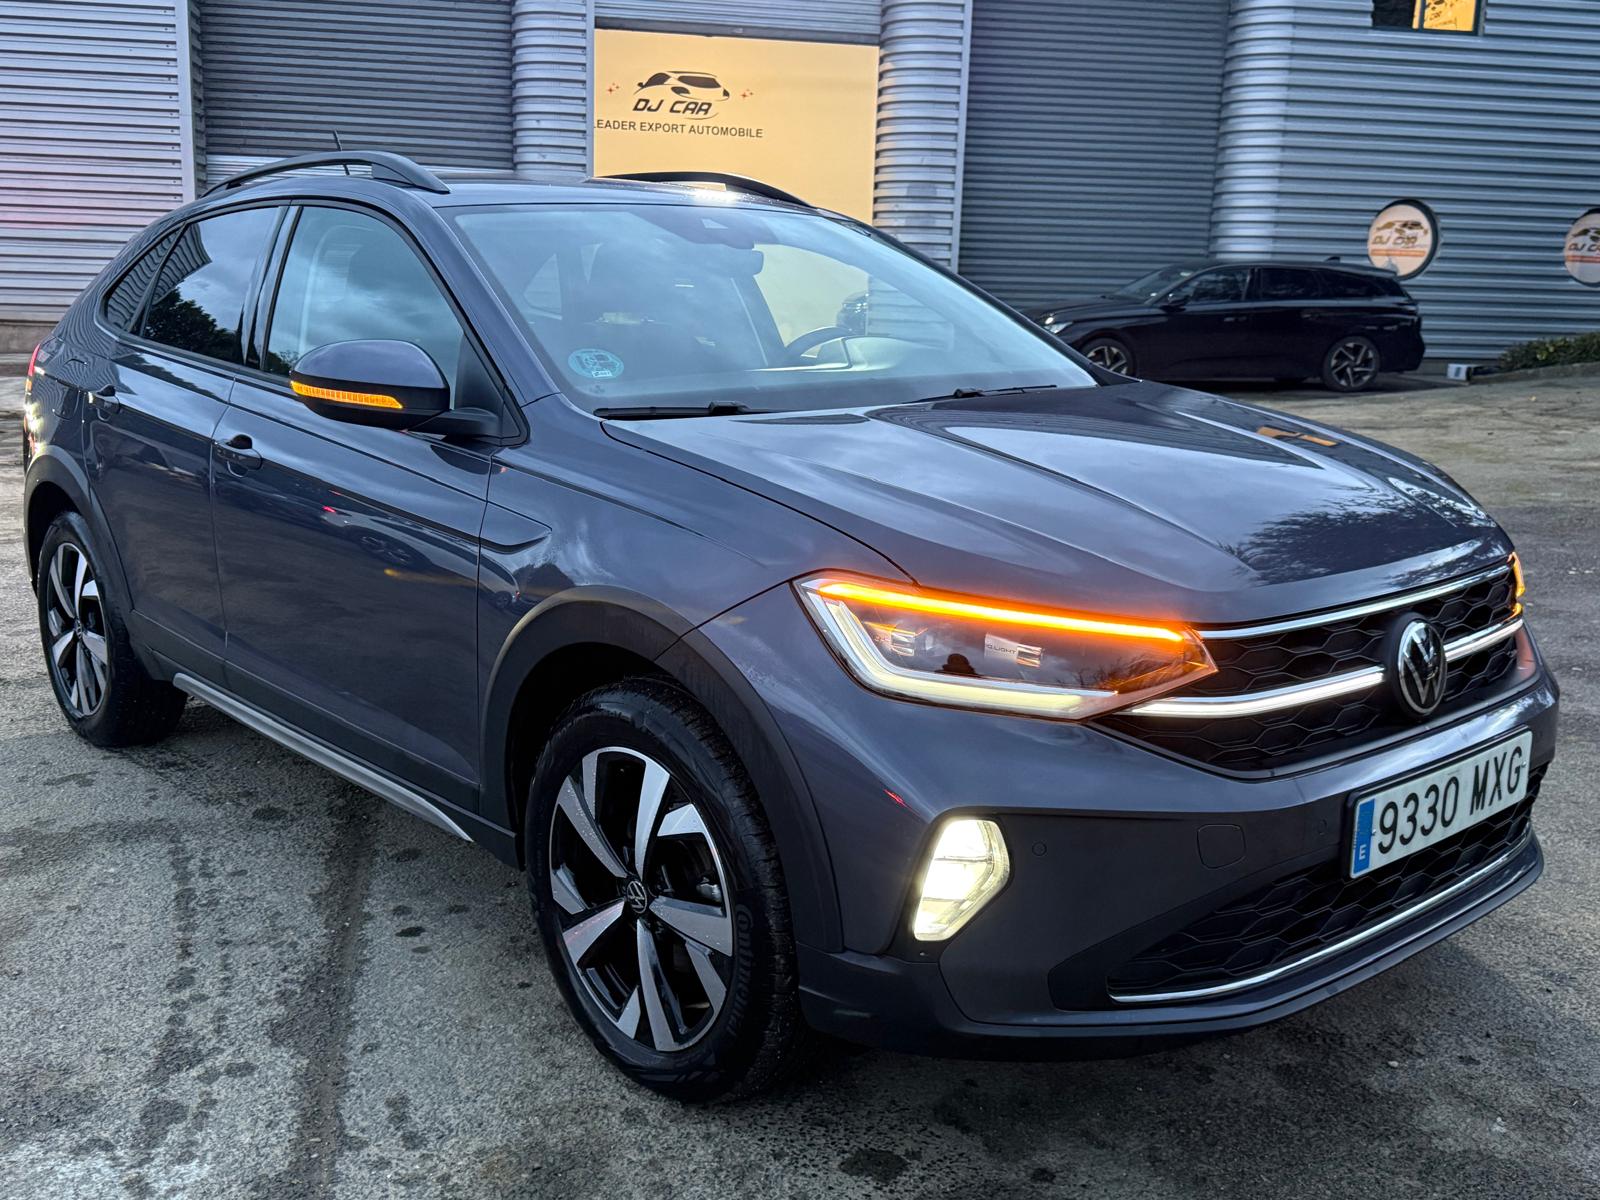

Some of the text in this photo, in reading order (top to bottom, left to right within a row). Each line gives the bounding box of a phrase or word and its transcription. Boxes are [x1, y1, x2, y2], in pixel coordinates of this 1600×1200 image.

[632, 98, 713, 115] DJ CAR
[593, 119, 764, 138] EADER EXPORT AUTOMOBILE
[1378, 746, 1523, 855] 9330 MXG
[1358, 844, 1368, 861] E
